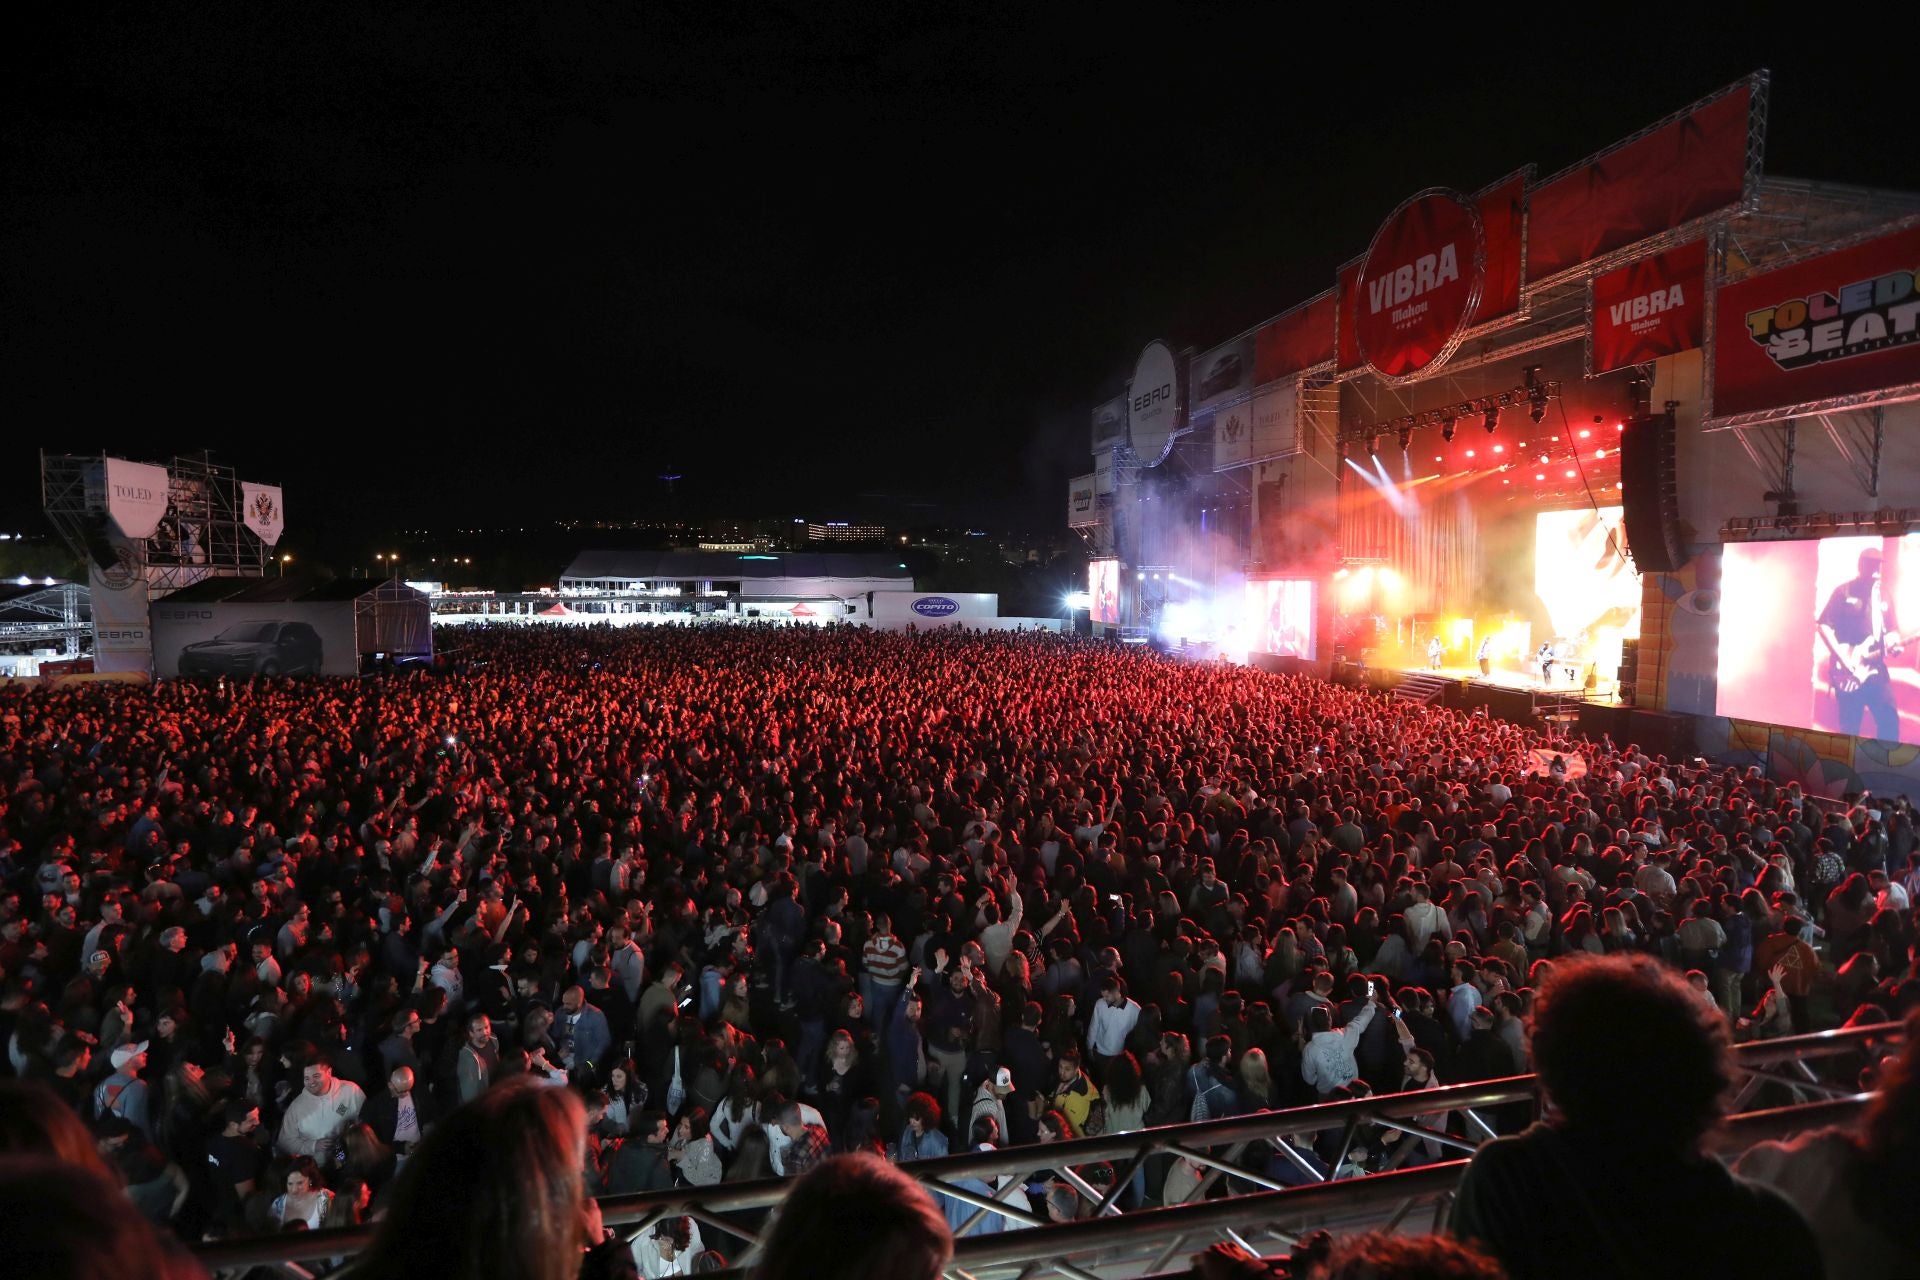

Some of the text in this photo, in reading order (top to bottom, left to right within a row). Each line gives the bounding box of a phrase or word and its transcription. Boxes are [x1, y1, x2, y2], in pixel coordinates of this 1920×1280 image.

[1368, 242, 1459, 315] VIBRA
[1391, 301, 1428, 324] Mahou
[1609, 283, 1685, 327] VIBRA
[1747, 273, 1920, 337] TOLED
[1630, 317, 1661, 332] Mahou
[1768, 300, 1920, 361] BEAT
[1134, 383, 1171, 412] EBRO
[159, 610, 213, 620] EBRO
[98, 631, 144, 639] EBRO
